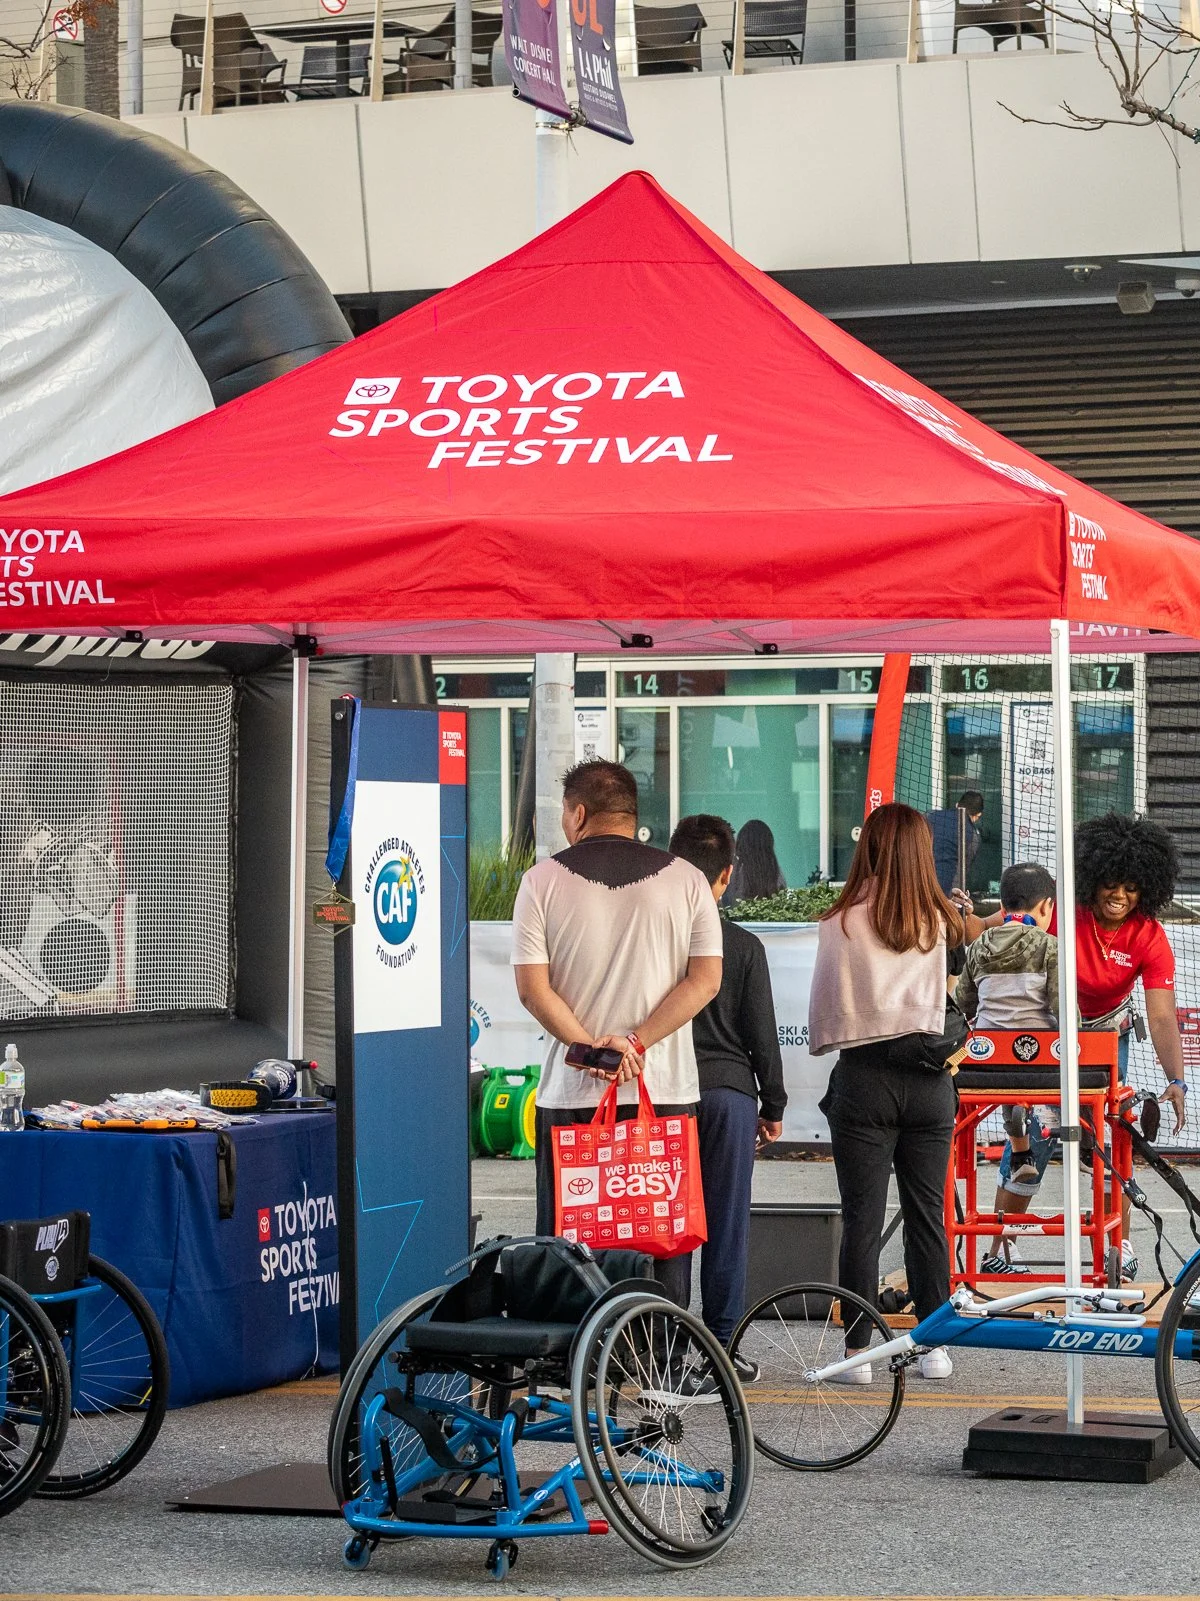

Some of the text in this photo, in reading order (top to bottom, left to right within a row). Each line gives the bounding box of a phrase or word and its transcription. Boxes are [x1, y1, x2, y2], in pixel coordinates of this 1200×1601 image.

[513, 56, 541, 82] CONCERT
[591, 53, 614, 90] Phil
[421, 371, 686, 404] TOYOTA
[328, 406, 584, 437] SPORTS
[427, 434, 734, 469] FESTIVAL
[1074, 518, 1107, 542] TOYOTA
[1070, 541, 1095, 569] SPORTS
[633, 674, 659, 695] 14
[847, 670, 873, 692] 15
[961, 668, 989, 690] 16
[1092, 666, 1120, 689] 17
[1019, 767, 1031, 775] NO
[364, 837, 426, 895] CHALLENGED ATHLETES
[376, 881, 414, 924] CAF
[376, 944, 416, 969] FOUNDATION
[778, 1026, 797, 1036] SKI
[971, 1044, 988, 1053] CAF
[605, 1156, 683, 1177] we make it
[605, 1170, 683, 1201] easy
[274, 1195, 338, 1238] TOYOTA
[260, 1237, 317, 1283] SPORTS
[1047, 1329, 1144, 1352] TOP END
